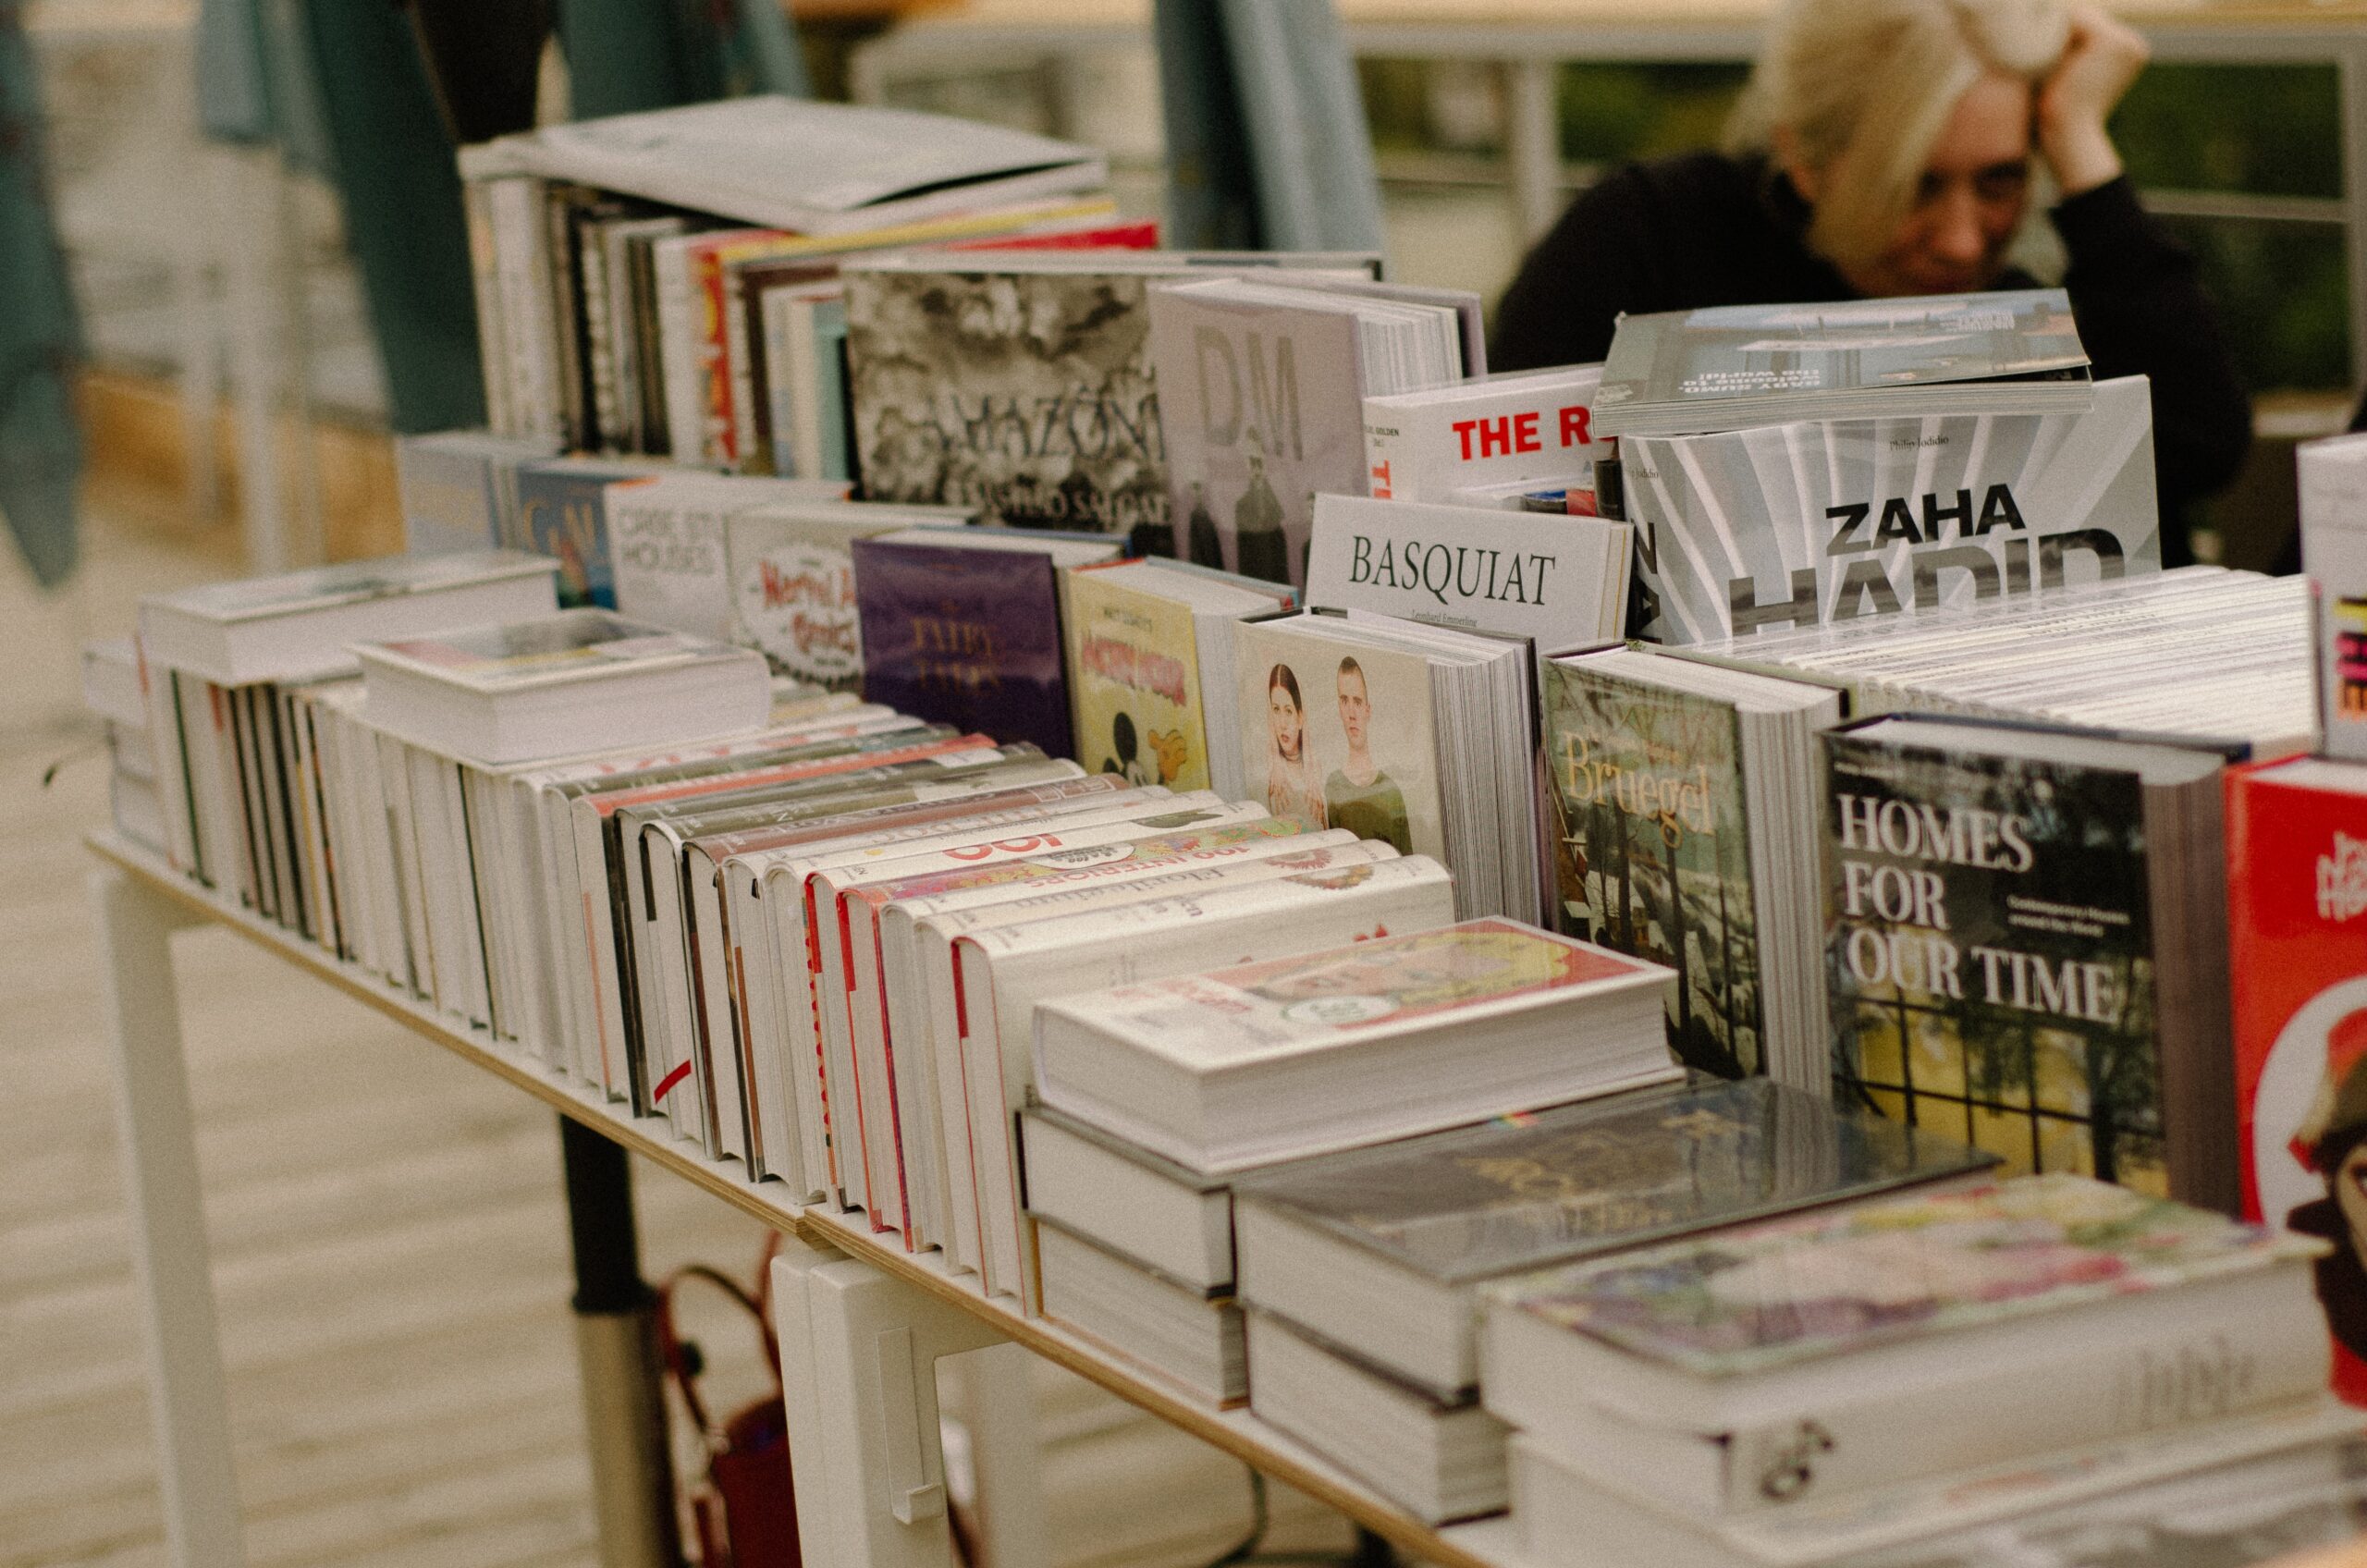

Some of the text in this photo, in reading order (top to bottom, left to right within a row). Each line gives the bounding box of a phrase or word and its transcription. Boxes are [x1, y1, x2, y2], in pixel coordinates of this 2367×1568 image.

[1452, 411, 1542, 461] THE
[1825, 482, 2026, 557] ZAHA
[1348, 535, 1556, 606] BASQUIAT
[1563, 729, 1716, 849] Bruegel
[1024, 844, 1250, 888] 100 INTERIORS
[1836, 792, 2035, 874] HOMES
[1016, 867, 1226, 910] Florilegium
[1842, 860, 1951, 931] FOR
[1846, 926, 2121, 1025] OUR TIME
